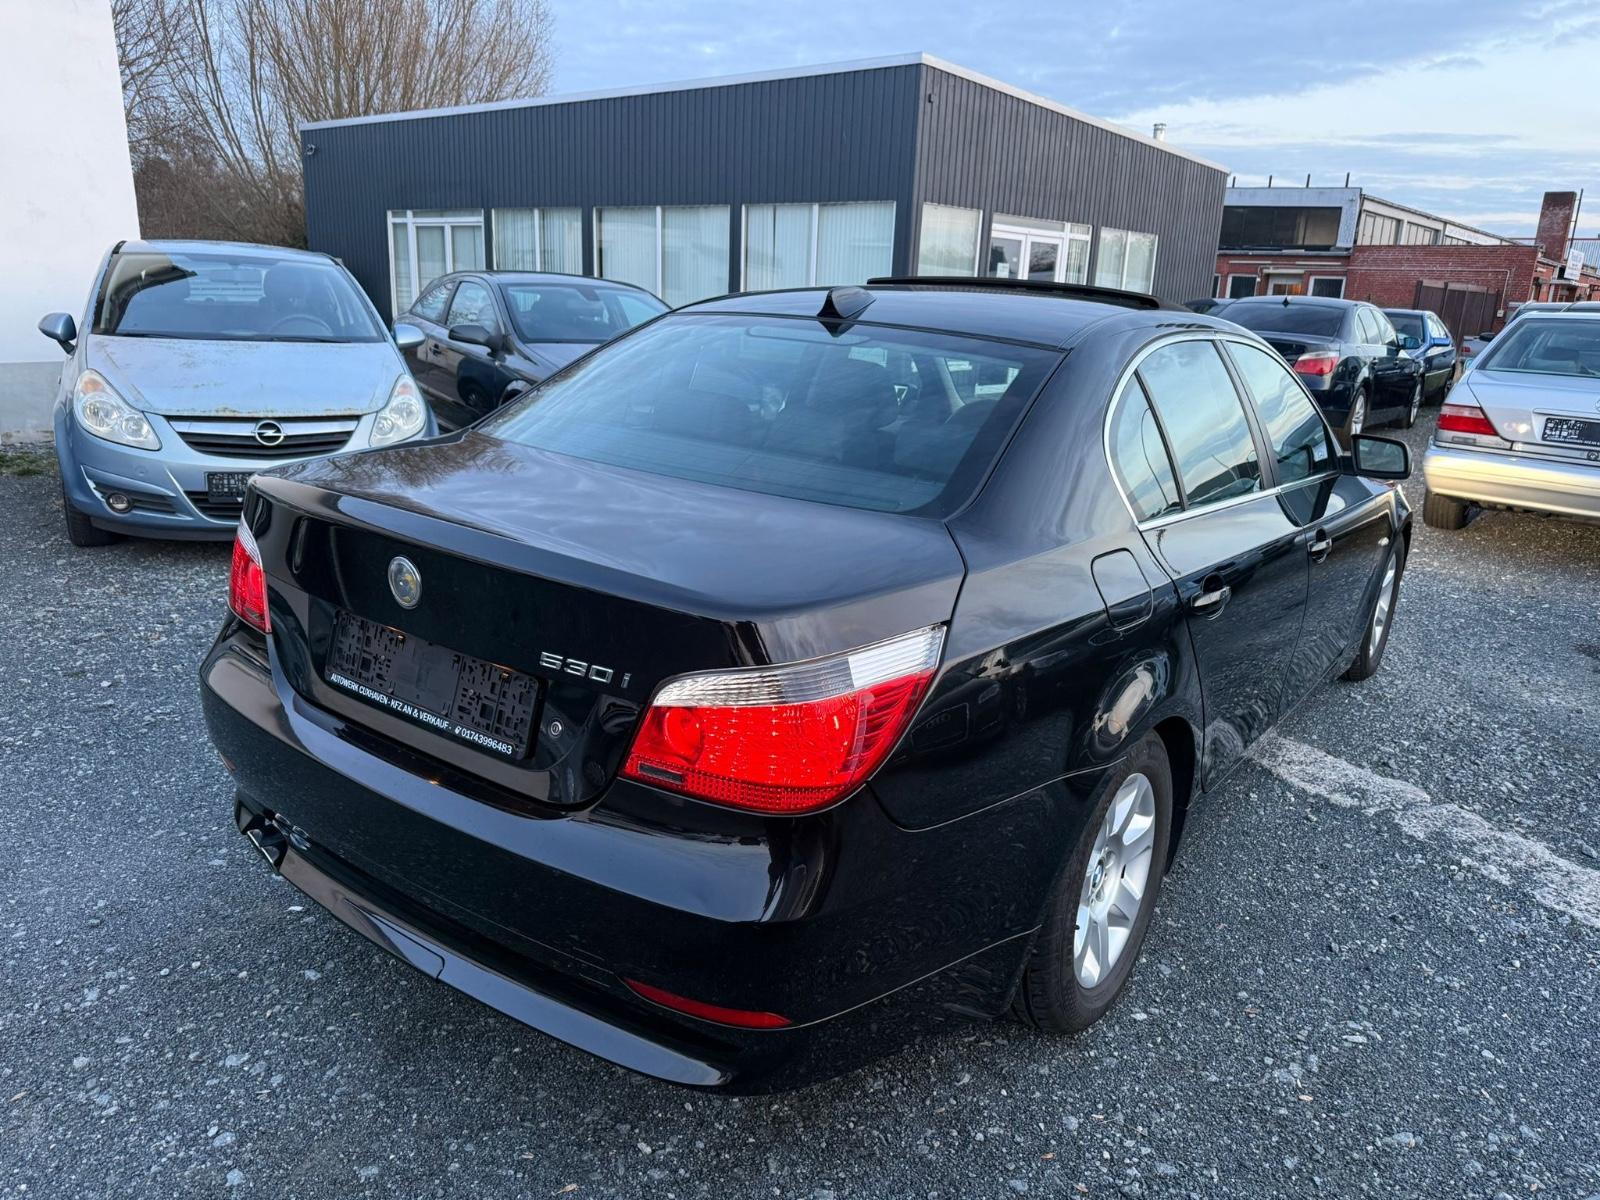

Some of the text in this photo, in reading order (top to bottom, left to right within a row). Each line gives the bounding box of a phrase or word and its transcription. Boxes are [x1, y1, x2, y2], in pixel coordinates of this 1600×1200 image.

[331, 673, 359, 692] AUTOWERK
[359, 686, 389, 705] CUXHAVEN
[390, 699, 402, 711] KFZ
[403, 705, 412, 715] AN
[413, 709, 418, 718] &
[420, 711, 449, 729] VERKAUF
[461, 728, 512, 755] 01743996483
